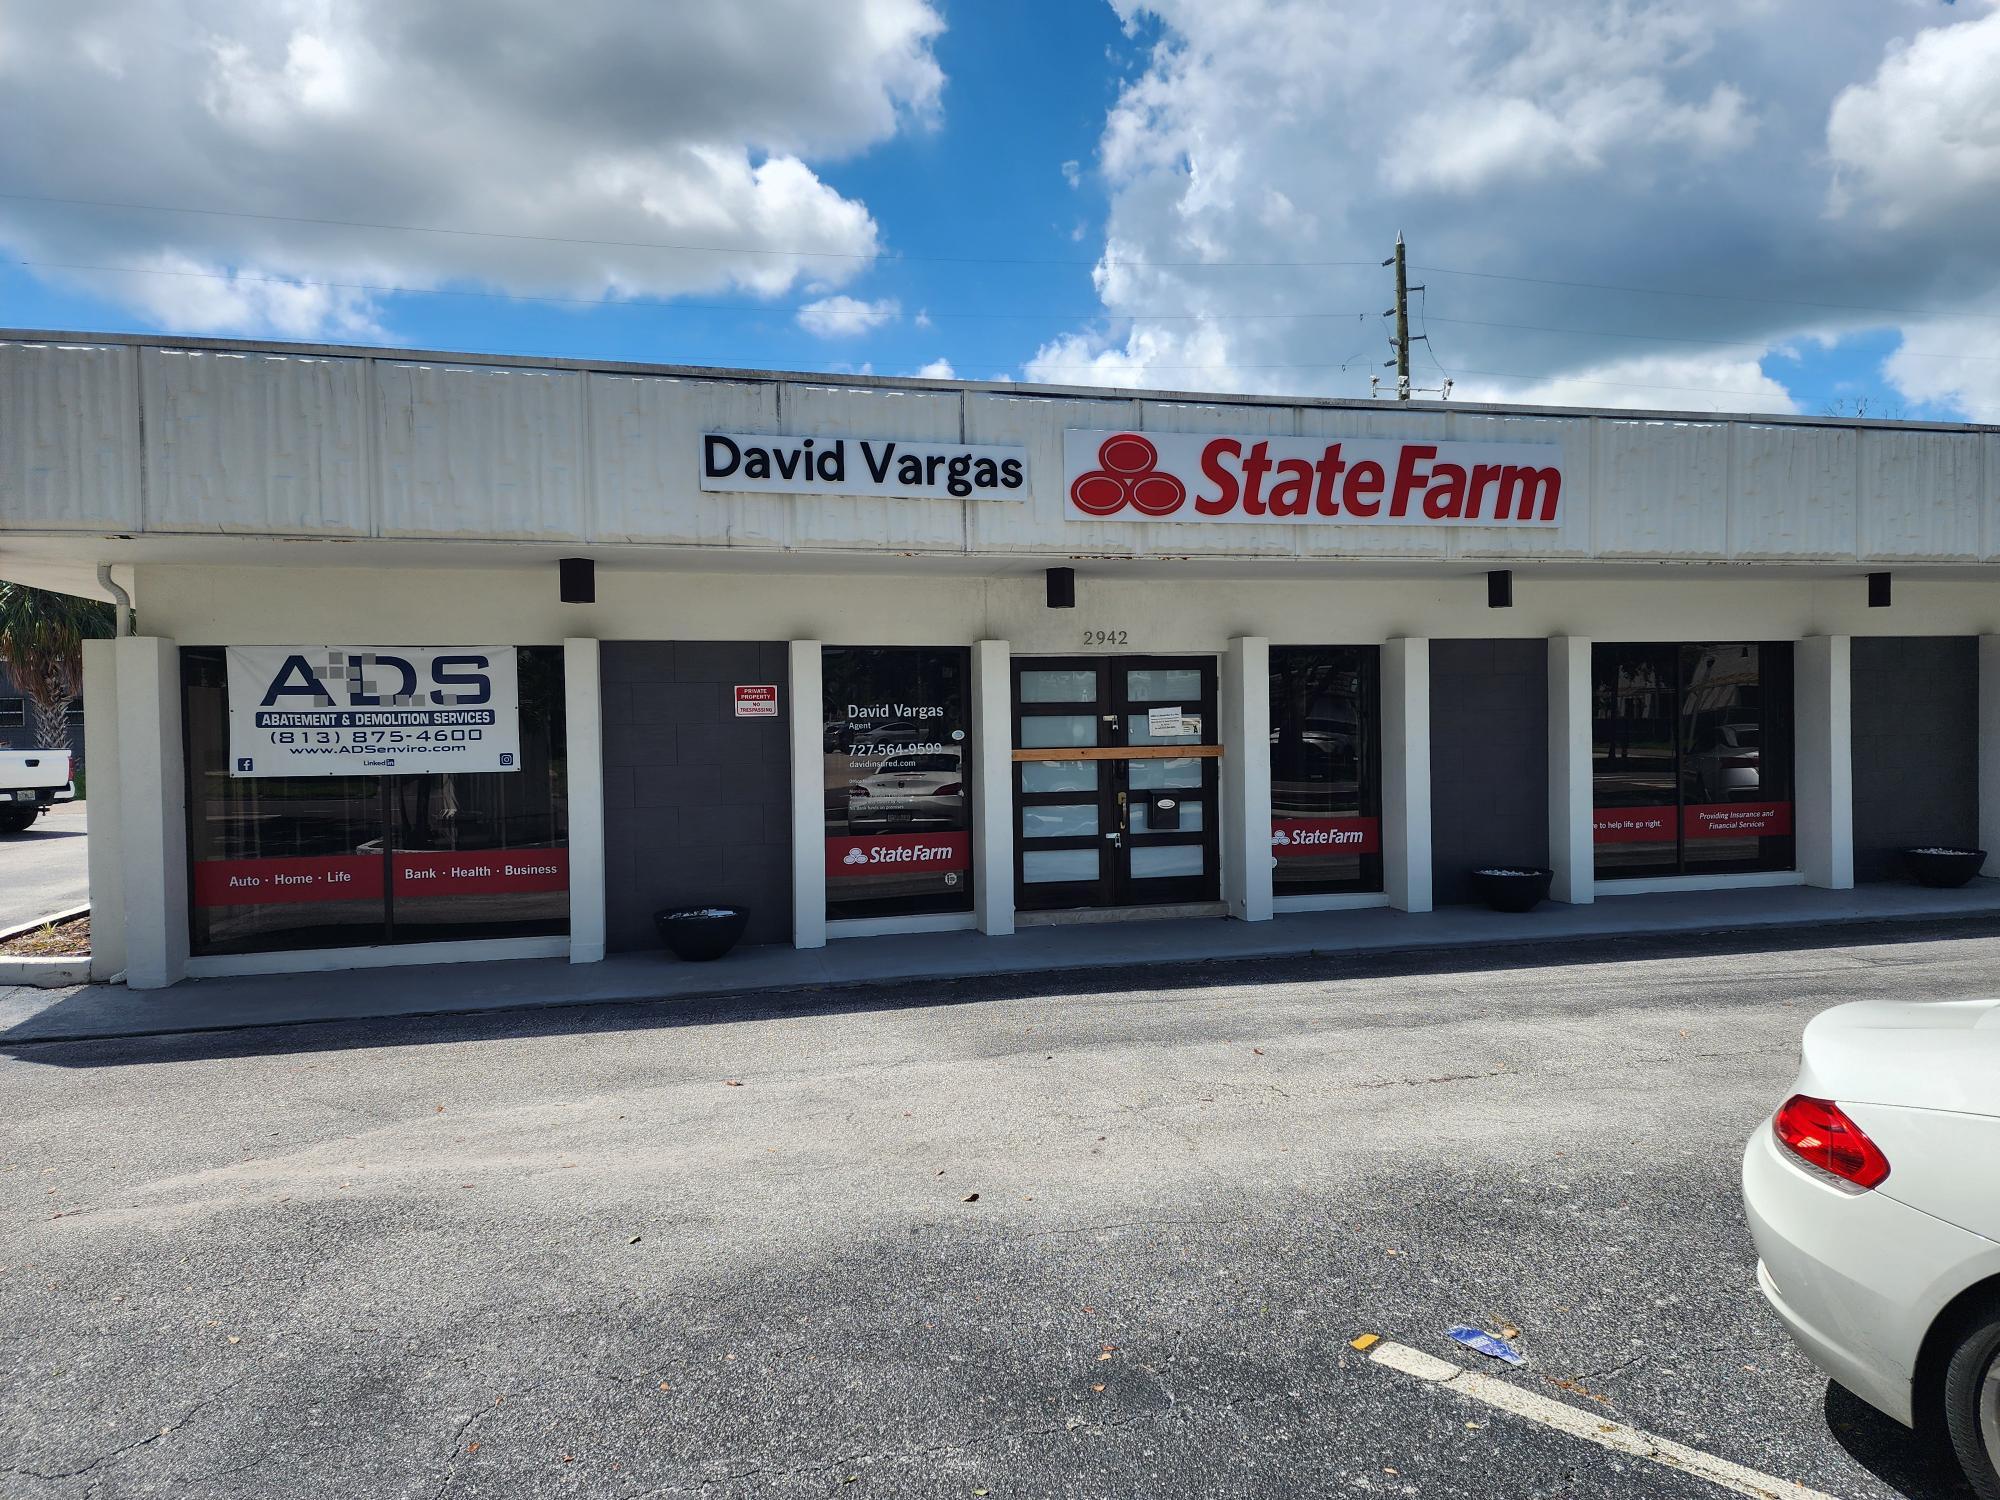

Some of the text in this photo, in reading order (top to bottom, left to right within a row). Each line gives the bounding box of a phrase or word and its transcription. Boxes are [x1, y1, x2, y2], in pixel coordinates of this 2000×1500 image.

[705, 435, 1024, 497] David Vargas
[1084, 631, 1128, 645] 2942
[260, 655, 490, 707] ADS
[262, 711, 490, 727] ABATEMENT & DEMOLITION SERVICES
[848, 704, 944, 720] David Vargas
[849, 722, 871, 730] Agent
[270, 729, 482, 745] (813) 875-4600
[290, 744, 466, 755] www.ADSenviro.com
[848, 743, 942, 757] 727-564-9599
[849, 759, 916, 768] davidinsured.com
[1699, 809, 1774, 821] Providing Insurance and
[1607, 821, 1622, 830] help
[1635, 822, 1644, 830] go
[1708, 820, 1765, 830] Financial Services
[229, 870, 351, 887] Auto Home Life
[405, 863, 558, 880] Bank Health Business
